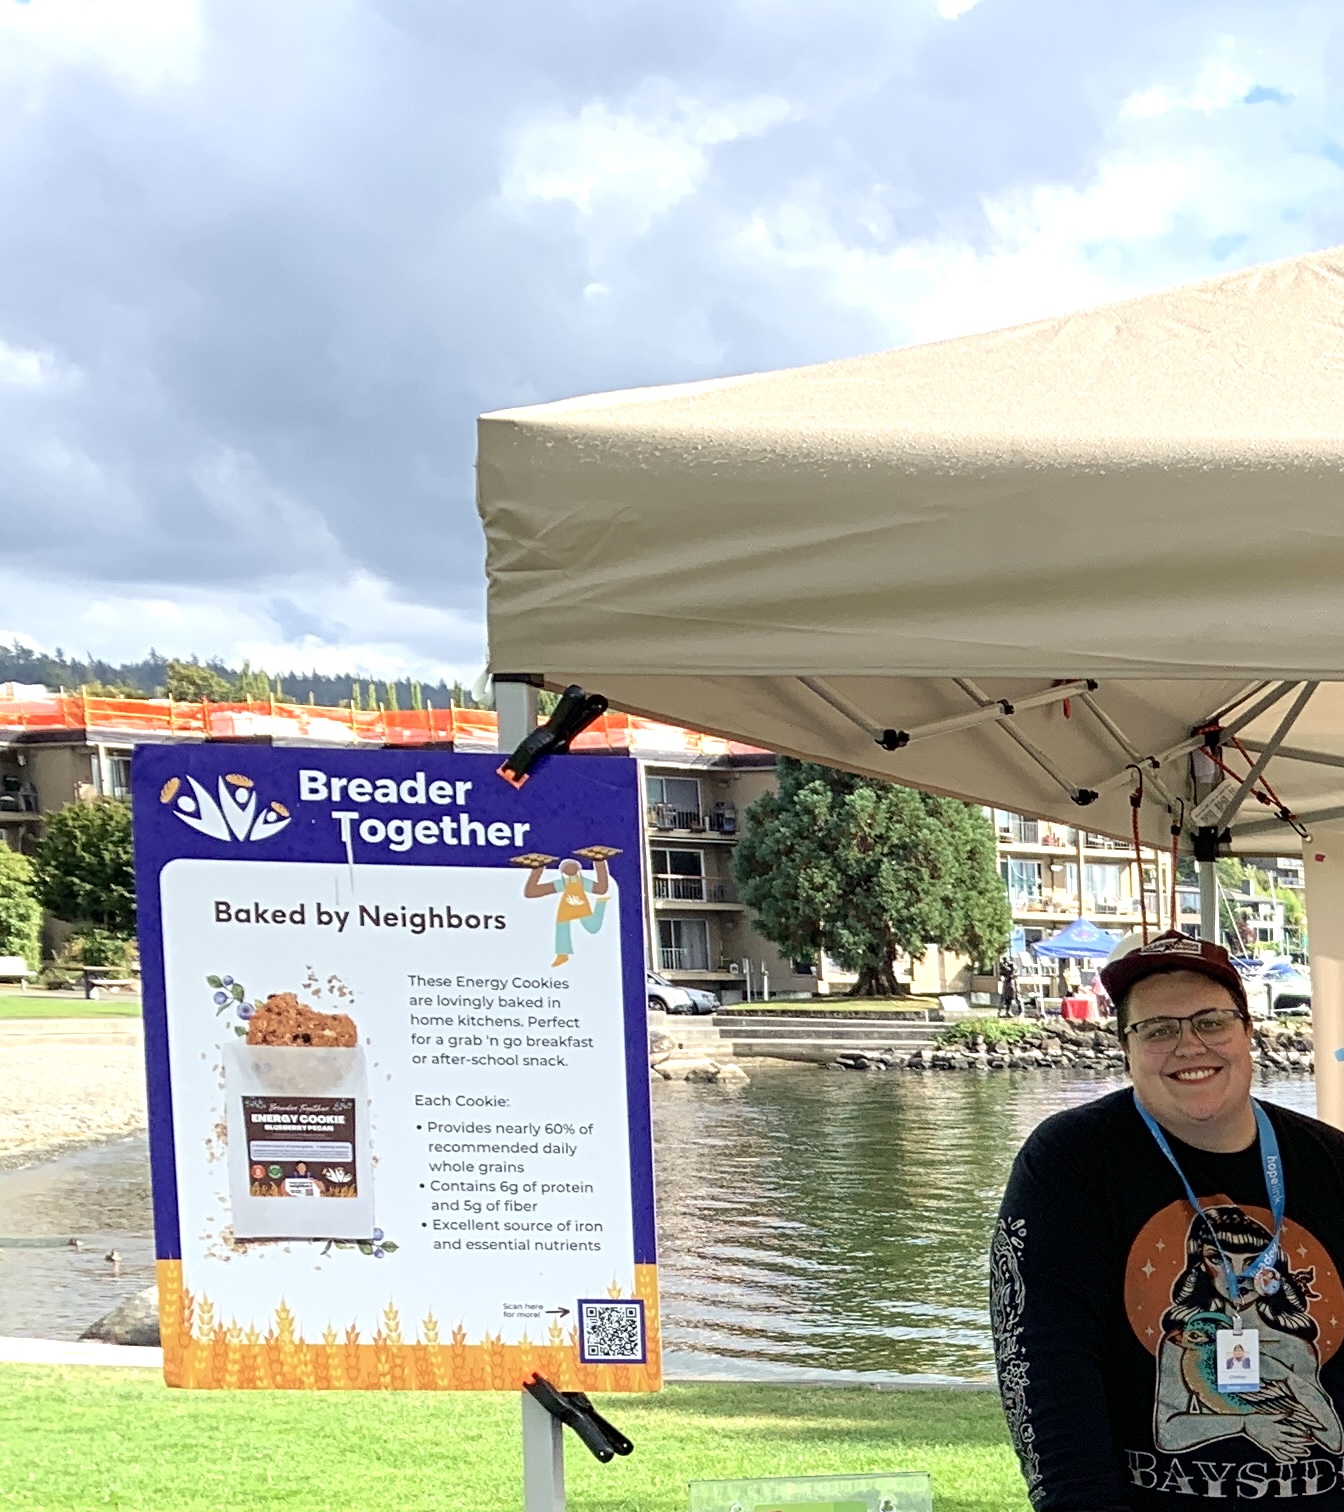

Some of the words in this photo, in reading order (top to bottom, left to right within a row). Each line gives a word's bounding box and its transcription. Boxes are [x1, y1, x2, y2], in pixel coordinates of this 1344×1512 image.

[299, 770, 472, 805] Breader
[331, 812, 530, 851] Together
[215, 901, 305, 925] Baked
[316, 903, 349, 932] by
[360, 905, 506, 934] Neighbors
[408, 975, 451, 987] These
[456, 976, 508, 990] Energy
[512, 977, 569, 989] Cookies
[410, 996, 432, 1006] are
[437, 995, 494, 1009] lovingly
[499, 996, 542, 1008] baked
[548, 997, 560, 1008] in
[411, 1014, 453, 1025] home
[458, 1015, 523, 1027] kitchens.
[528, 1016, 579, 1028] Perfect
[411, 1034, 431, 1044] for
[436, 1037, 443, 1045] a
[449, 1034, 482, 1047] grab
[487, 1035, 498, 1046] 'n
[503, 1037, 521, 1049] go
[527, 1036, 594, 1047] breakfast
[412, 1055, 426, 1064] or
[432, 1053, 518, 1065] after-school
[523, 1055, 568, 1066] snack.
[415, 1095, 450, 1106] Each
[456, 1096, 510, 1107] Cookie:
[251, 1114, 297, 1123] ENERGY
[300, 1115, 345, 1124] COOKIE
[428, 1122, 491, 1133] Provides
[496, 1123, 540, 1136] nearly
[545, 1123, 575, 1134] 60%
[579, 1123, 593, 1134] of
[428, 1142, 538, 1153] recommended
[543, 1143, 577, 1156] daily
[429, 1161, 474, 1172] whole
[479, 1162, 524, 1175] grains
[431, 1180, 495, 1191] Contains
[500, 1181, 518, 1194] 6g
[523, 1181, 537, 1192] of
[541, 1183, 593, 1194] protein
[432, 1200, 459, 1211] and
[464, 1201, 481, 1213] 5g
[486, 1200, 500, 1211] of
[505, 1200, 537, 1211] fiber
[433, 1219, 499, 1231] Excellent
[504, 1222, 552, 1231] source
[557, 1220, 571, 1231] of
[576, 1220, 603, 1231] iron
[434, 1239, 461, 1249] and
[466, 1239, 530, 1250] essential
[535, 1240, 600, 1251] nutrients
